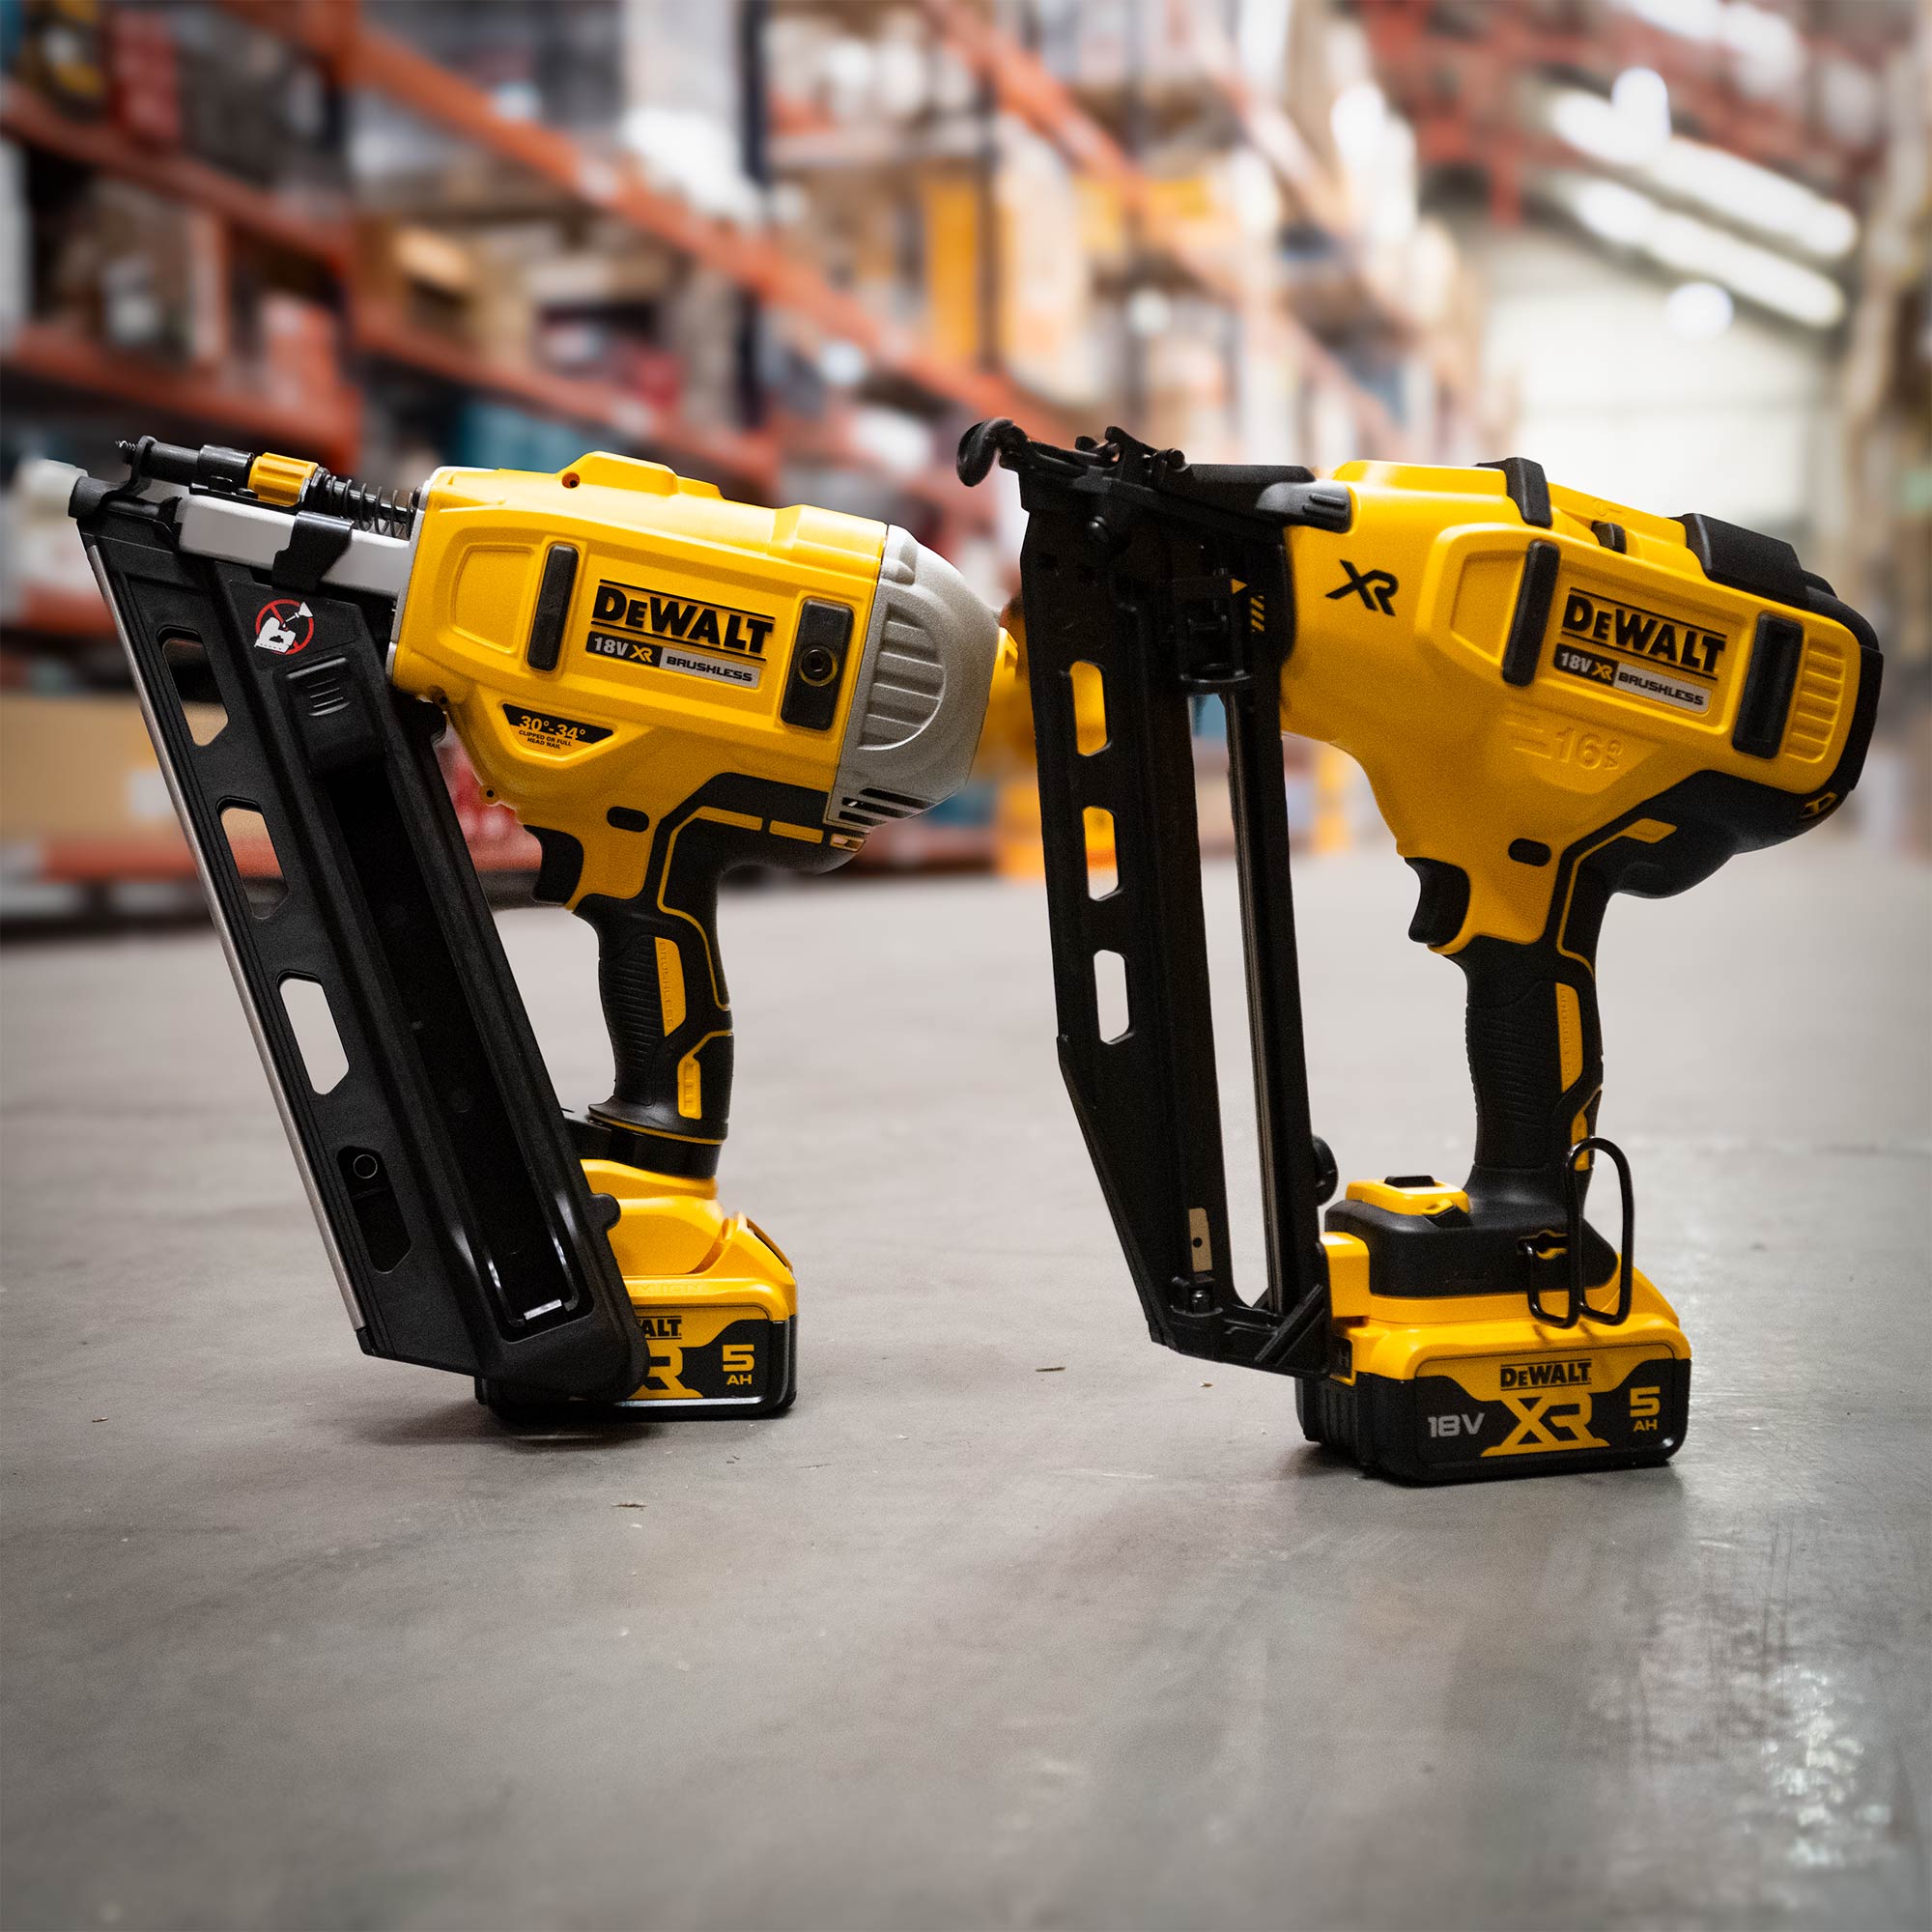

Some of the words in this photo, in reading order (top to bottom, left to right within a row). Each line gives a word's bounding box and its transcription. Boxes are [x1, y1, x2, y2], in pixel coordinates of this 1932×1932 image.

[1325, 558, 1399, 616] XR
[594, 637, 629, 657] 18V
[629, 644, 653, 664] XR
[667, 656, 753, 682] BRUSHLESS
[1560, 651, 1592, 674] 18V
[1618, 670, 1704, 706] BRUSHLESS
[519, 729, 545, 740] CLIPPED
[556, 738, 572, 747] FULL
[527, 737, 545, 746] HEAD
[1554, 726, 1602, 770] 16
[638, 1319, 682, 1338] ALT
[634, 1345, 703, 1398] R
[723, 1344, 755, 1372] 5
[726, 1374, 753, 1385] AH
[1630, 1386, 1661, 1418] 5
[1428, 1412, 1485, 1437] 18V
[1481, 1392, 1611, 1457] XR
[1634, 1418, 1658, 1433] AH
